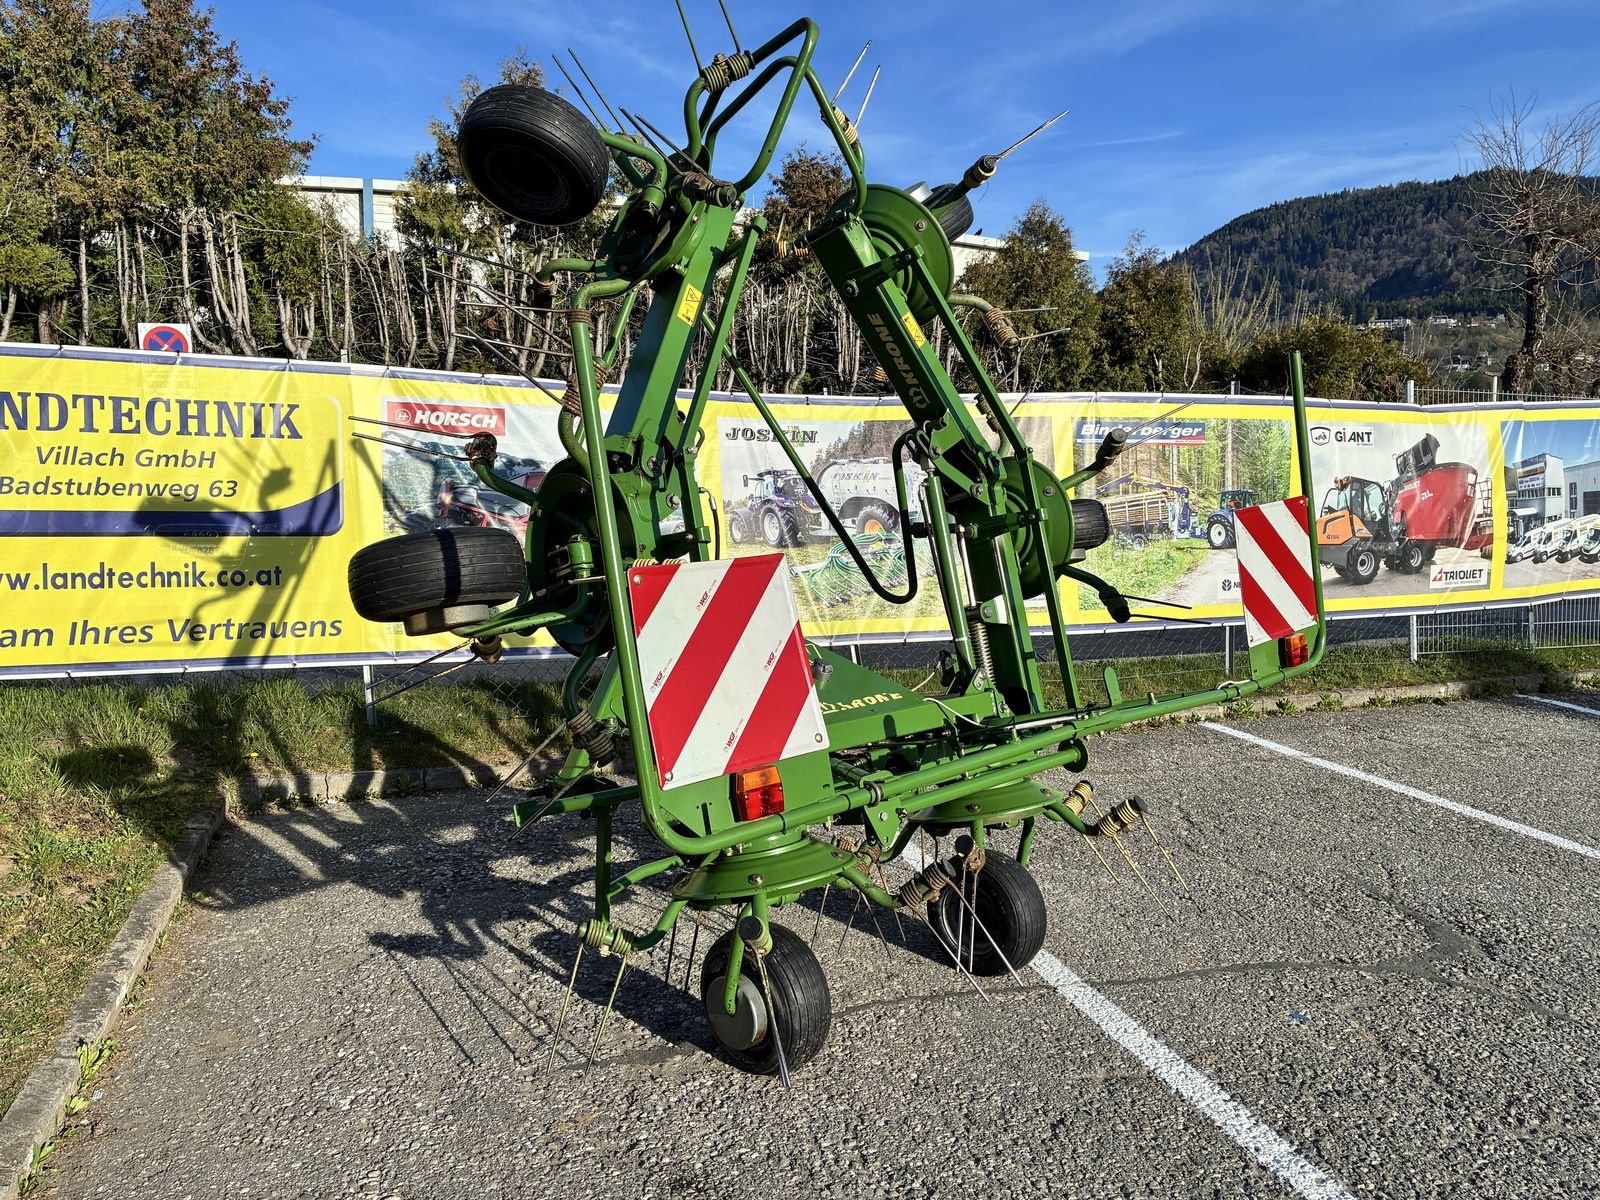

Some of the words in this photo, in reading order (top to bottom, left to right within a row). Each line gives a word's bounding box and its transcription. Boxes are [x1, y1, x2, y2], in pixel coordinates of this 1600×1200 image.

[867, 313, 919, 385] KRONE
[0, 391, 303, 439] NDTECHNIK
[414, 410, 497, 428] HORSCH
[36, 445, 125, 467] Villach
[135, 448, 217, 469] GmbH
[0, 475, 199, 502] Badstubenweg
[209, 480, 239, 498] 63
[0, 561, 282, 590] w.landtechnik.co.at
[68, 619, 154, 646] Ihres
[167, 617, 343, 642] Vertrauens
